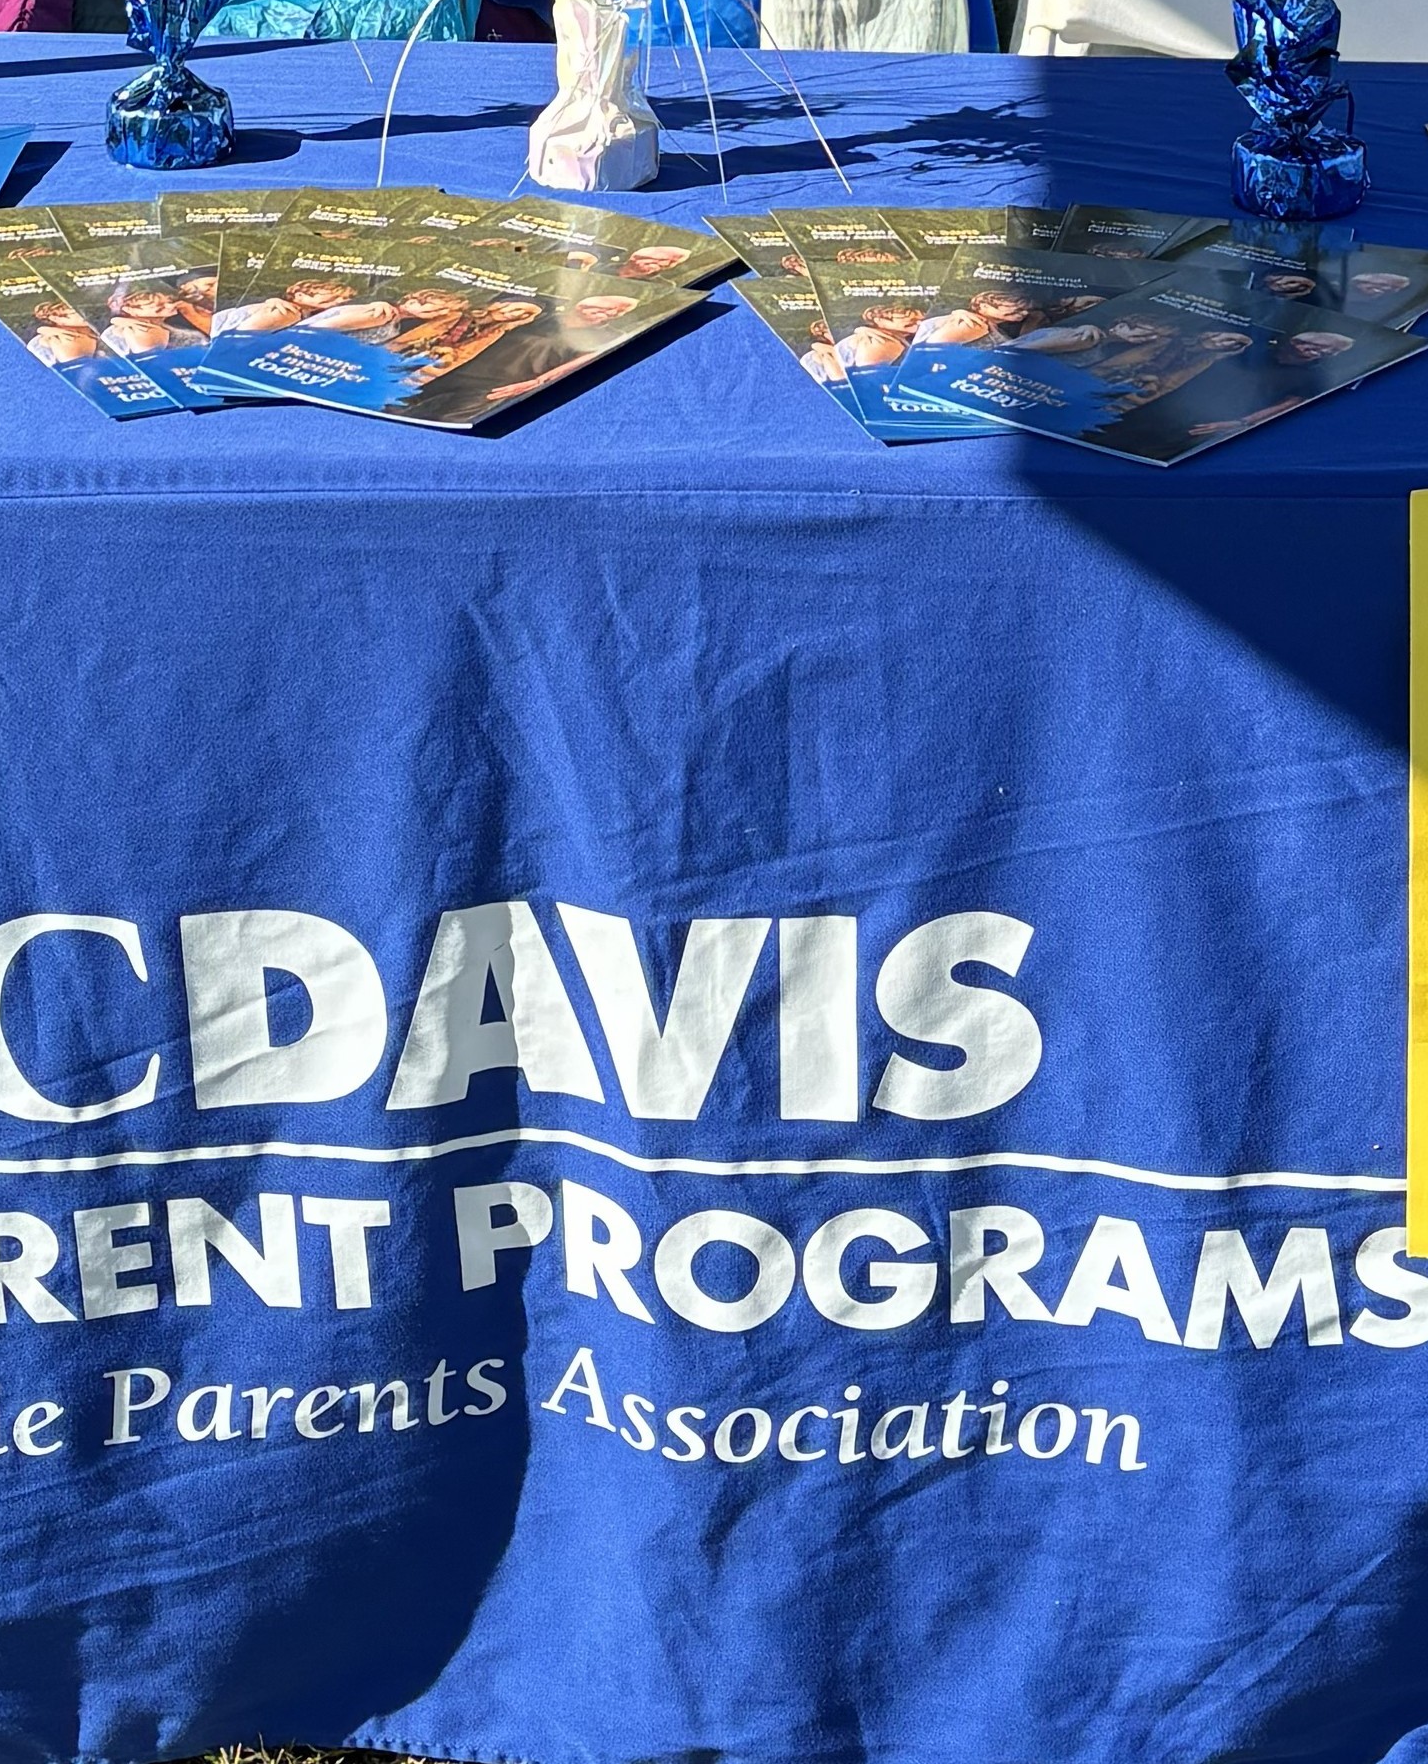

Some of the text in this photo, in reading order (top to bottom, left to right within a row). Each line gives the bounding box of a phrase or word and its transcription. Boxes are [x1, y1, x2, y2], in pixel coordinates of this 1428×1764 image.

[247, 357, 338, 388] today!
[264, 351, 372, 384] a member
[279, 343, 363, 372] Become
[949, 378, 1038, 411] today!
[967, 372, 1071, 408] a member
[982, 364, 1065, 396] Become
[100, 1347, 510, 1449] Parents
[539, 1343, 1149, 1475] Association
